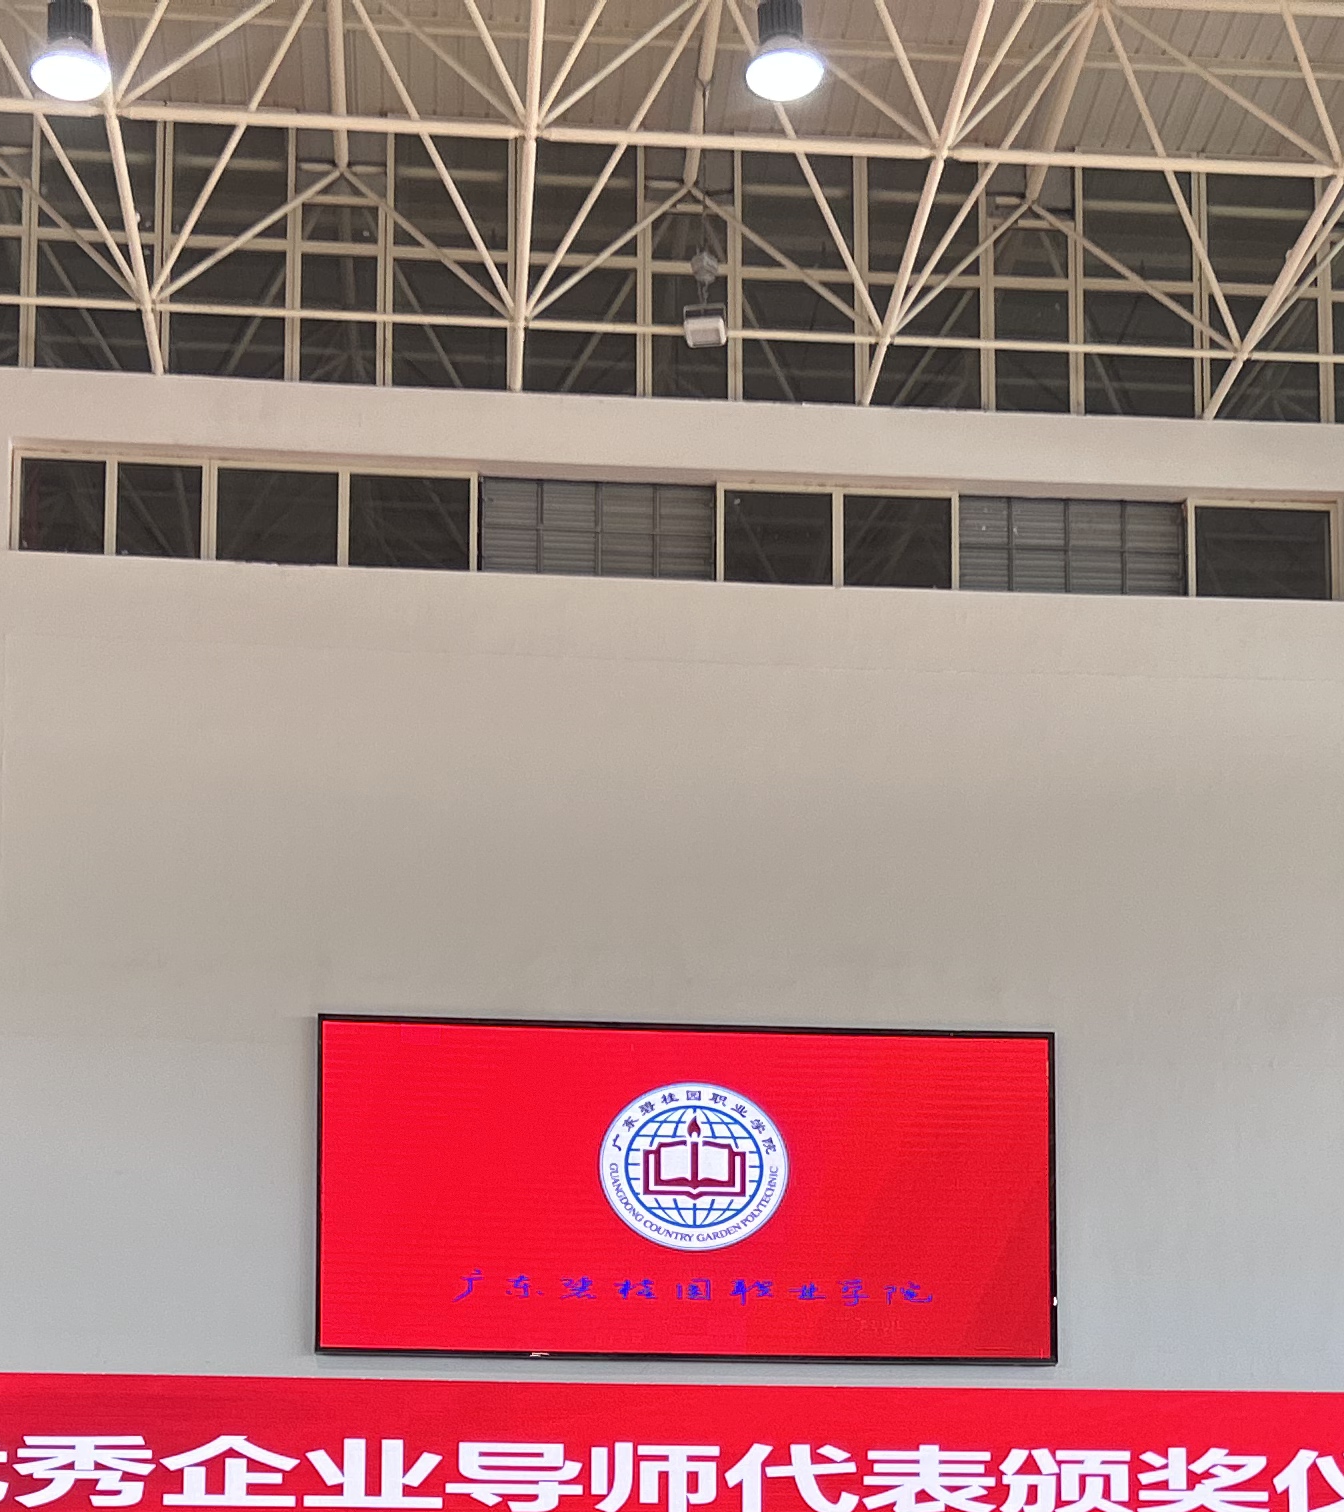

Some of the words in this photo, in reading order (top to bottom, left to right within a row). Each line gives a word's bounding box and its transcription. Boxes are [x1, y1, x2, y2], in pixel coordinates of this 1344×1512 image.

[612, 1090, 777, 1155] 广东碧桂园职业学院
[609, 1163, 645, 1223] GUANGDONG
[643, 1219, 694, 1242] COUNTRY
[696, 1222, 742, 1242] GARDEN
[742, 1166, 779, 1229] POLYTECHNIC
